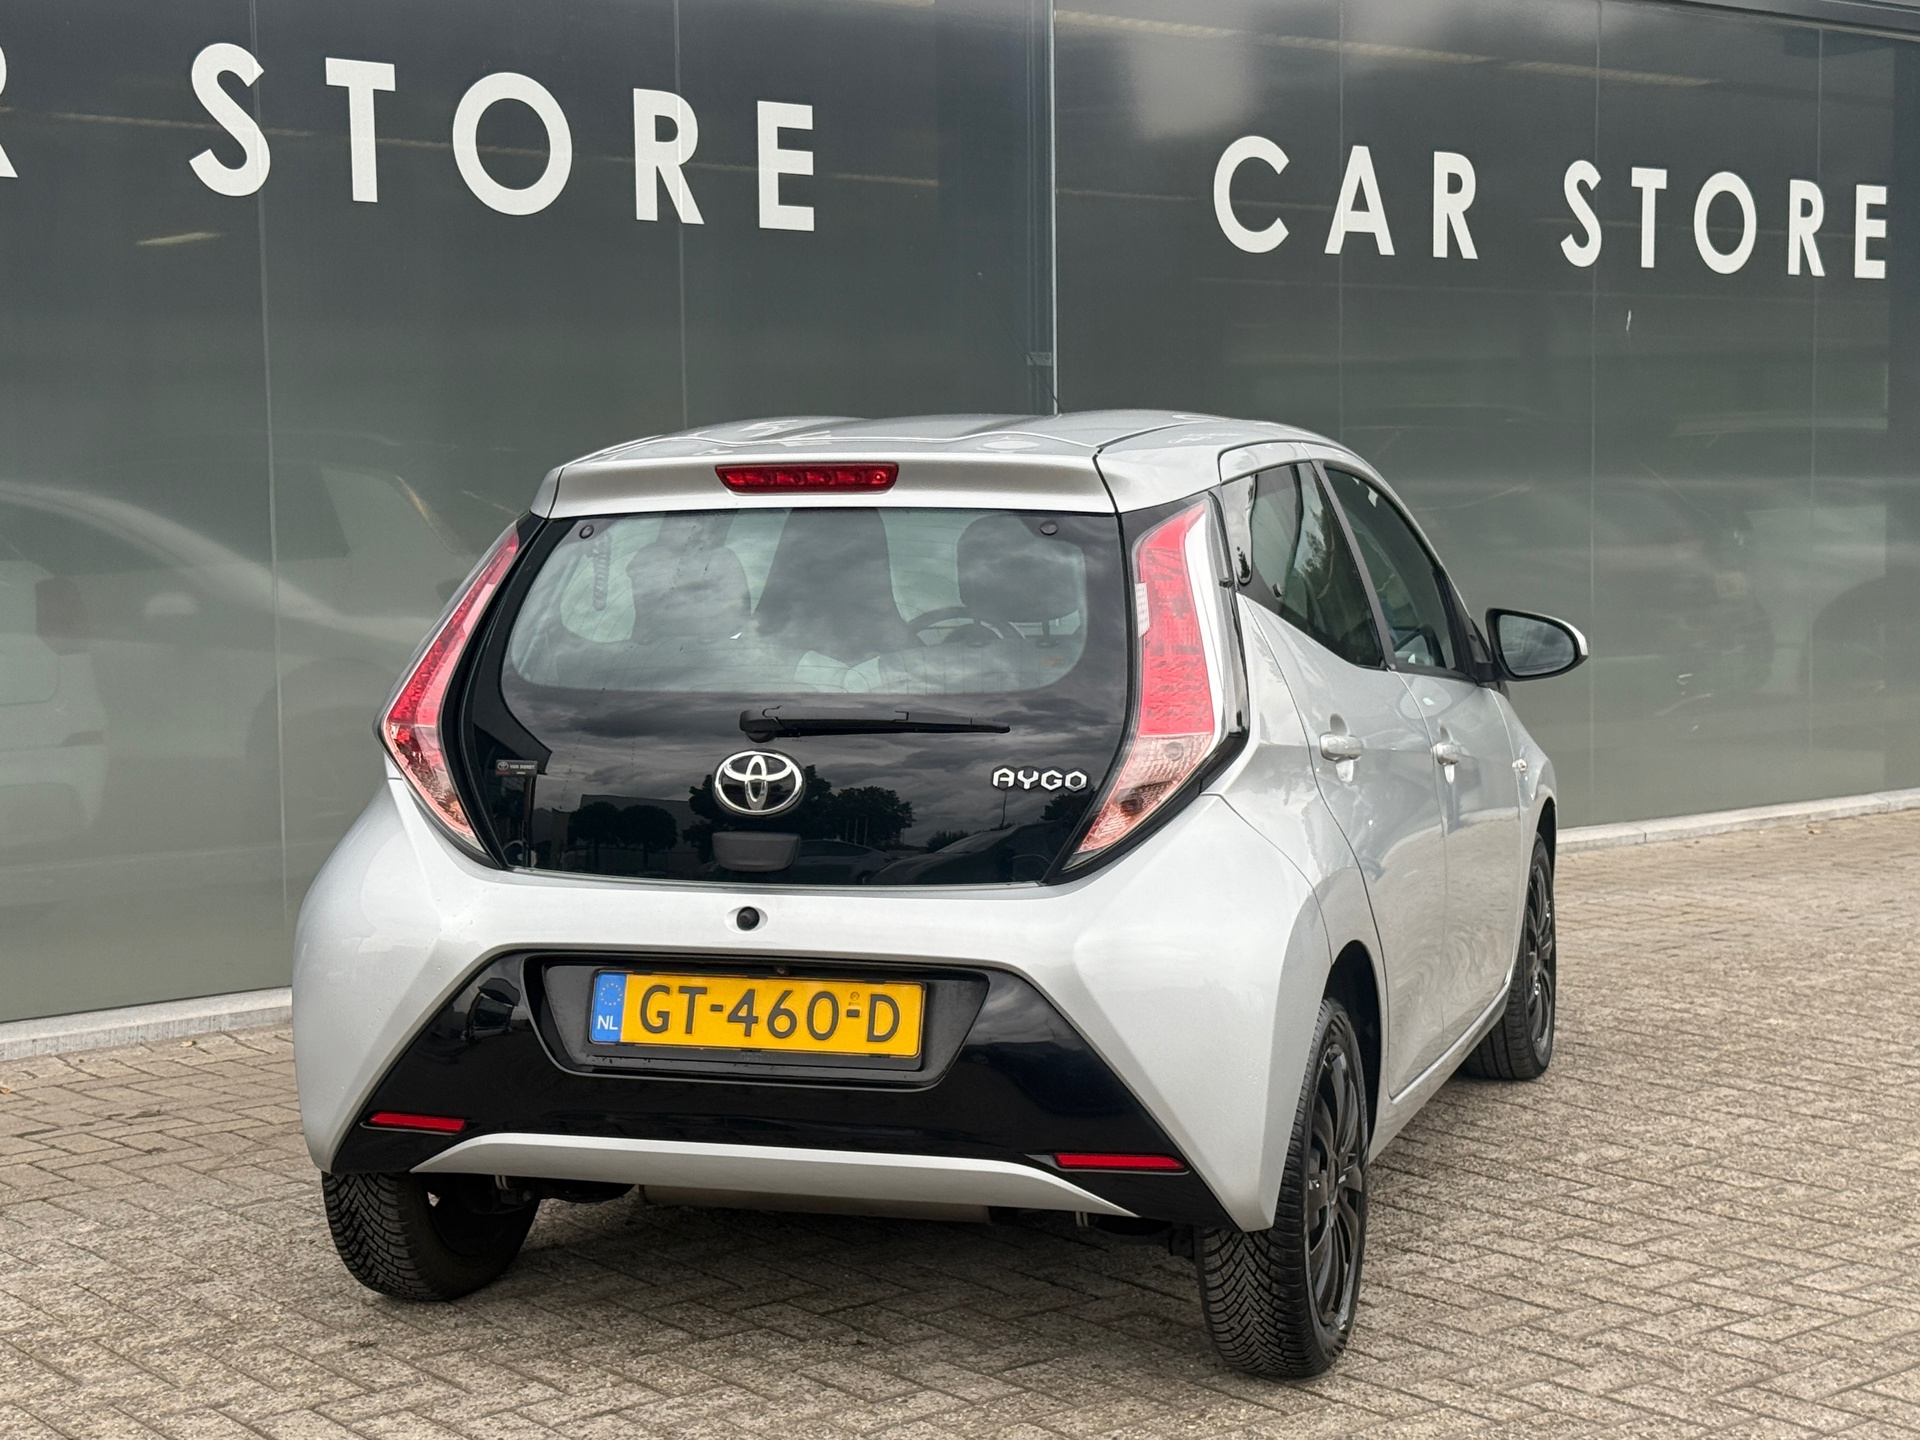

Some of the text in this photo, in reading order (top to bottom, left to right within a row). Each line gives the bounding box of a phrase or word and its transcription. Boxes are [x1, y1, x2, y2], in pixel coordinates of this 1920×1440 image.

[188, 42, 815, 232] STORE
[1213, 134, 1888, 280] CAR STORE
[991, 767, 1088, 792] AYGO
[596, 1014, 619, 1031] NL
[639, 984, 901, 1043] GT-460-D
